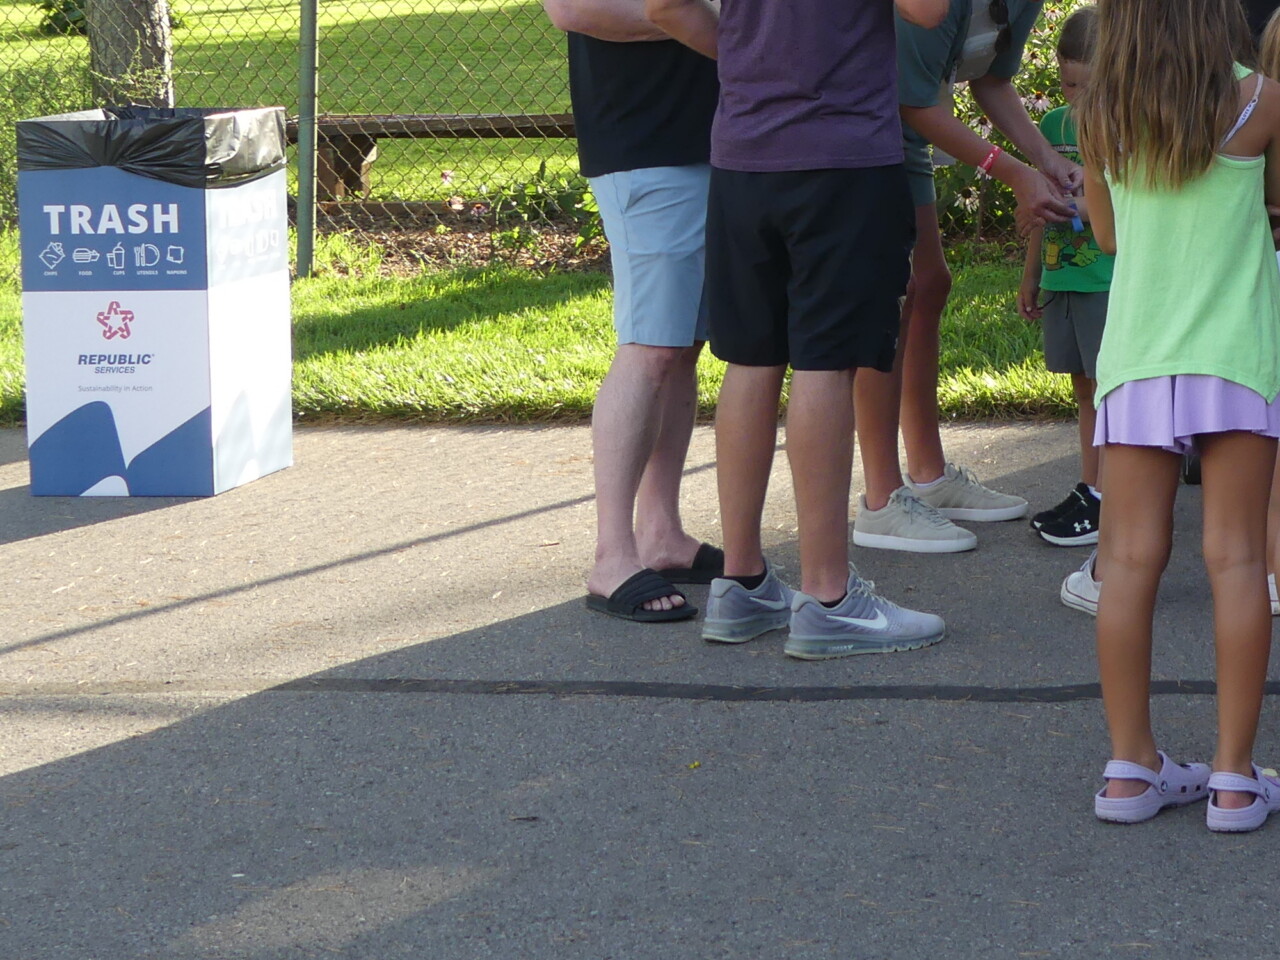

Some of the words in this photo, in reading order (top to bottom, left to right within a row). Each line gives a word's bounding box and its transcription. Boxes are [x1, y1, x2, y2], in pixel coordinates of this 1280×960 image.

[43, 203, 180, 236] TRASH
[78, 354, 153, 366] REPUBLIC
[94, 366, 136, 374] SERVICES
[78, 385, 122, 394] Sustainability
